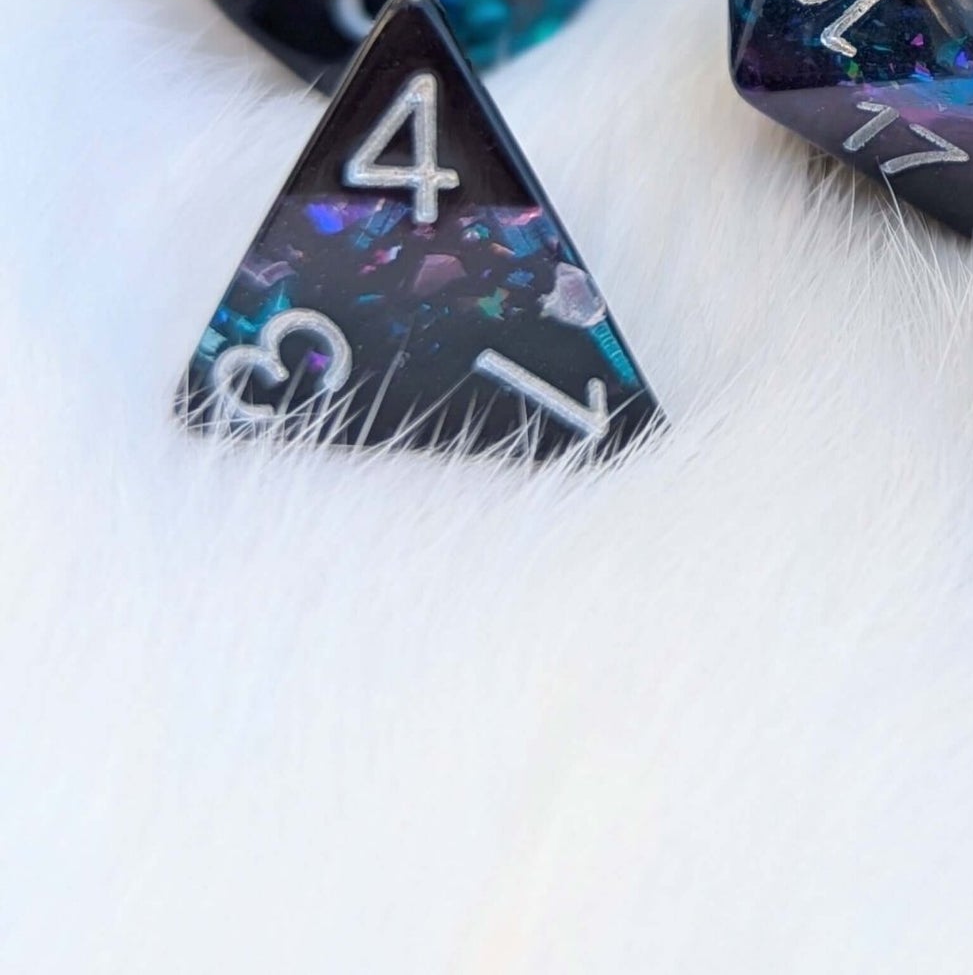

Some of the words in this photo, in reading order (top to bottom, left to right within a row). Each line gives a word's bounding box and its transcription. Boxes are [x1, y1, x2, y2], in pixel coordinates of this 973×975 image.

[344, 72, 460, 224] 4
[843, 101, 969, 175] 17
[214, 308, 352, 420] 3
[473, 347, 609, 436] 1
